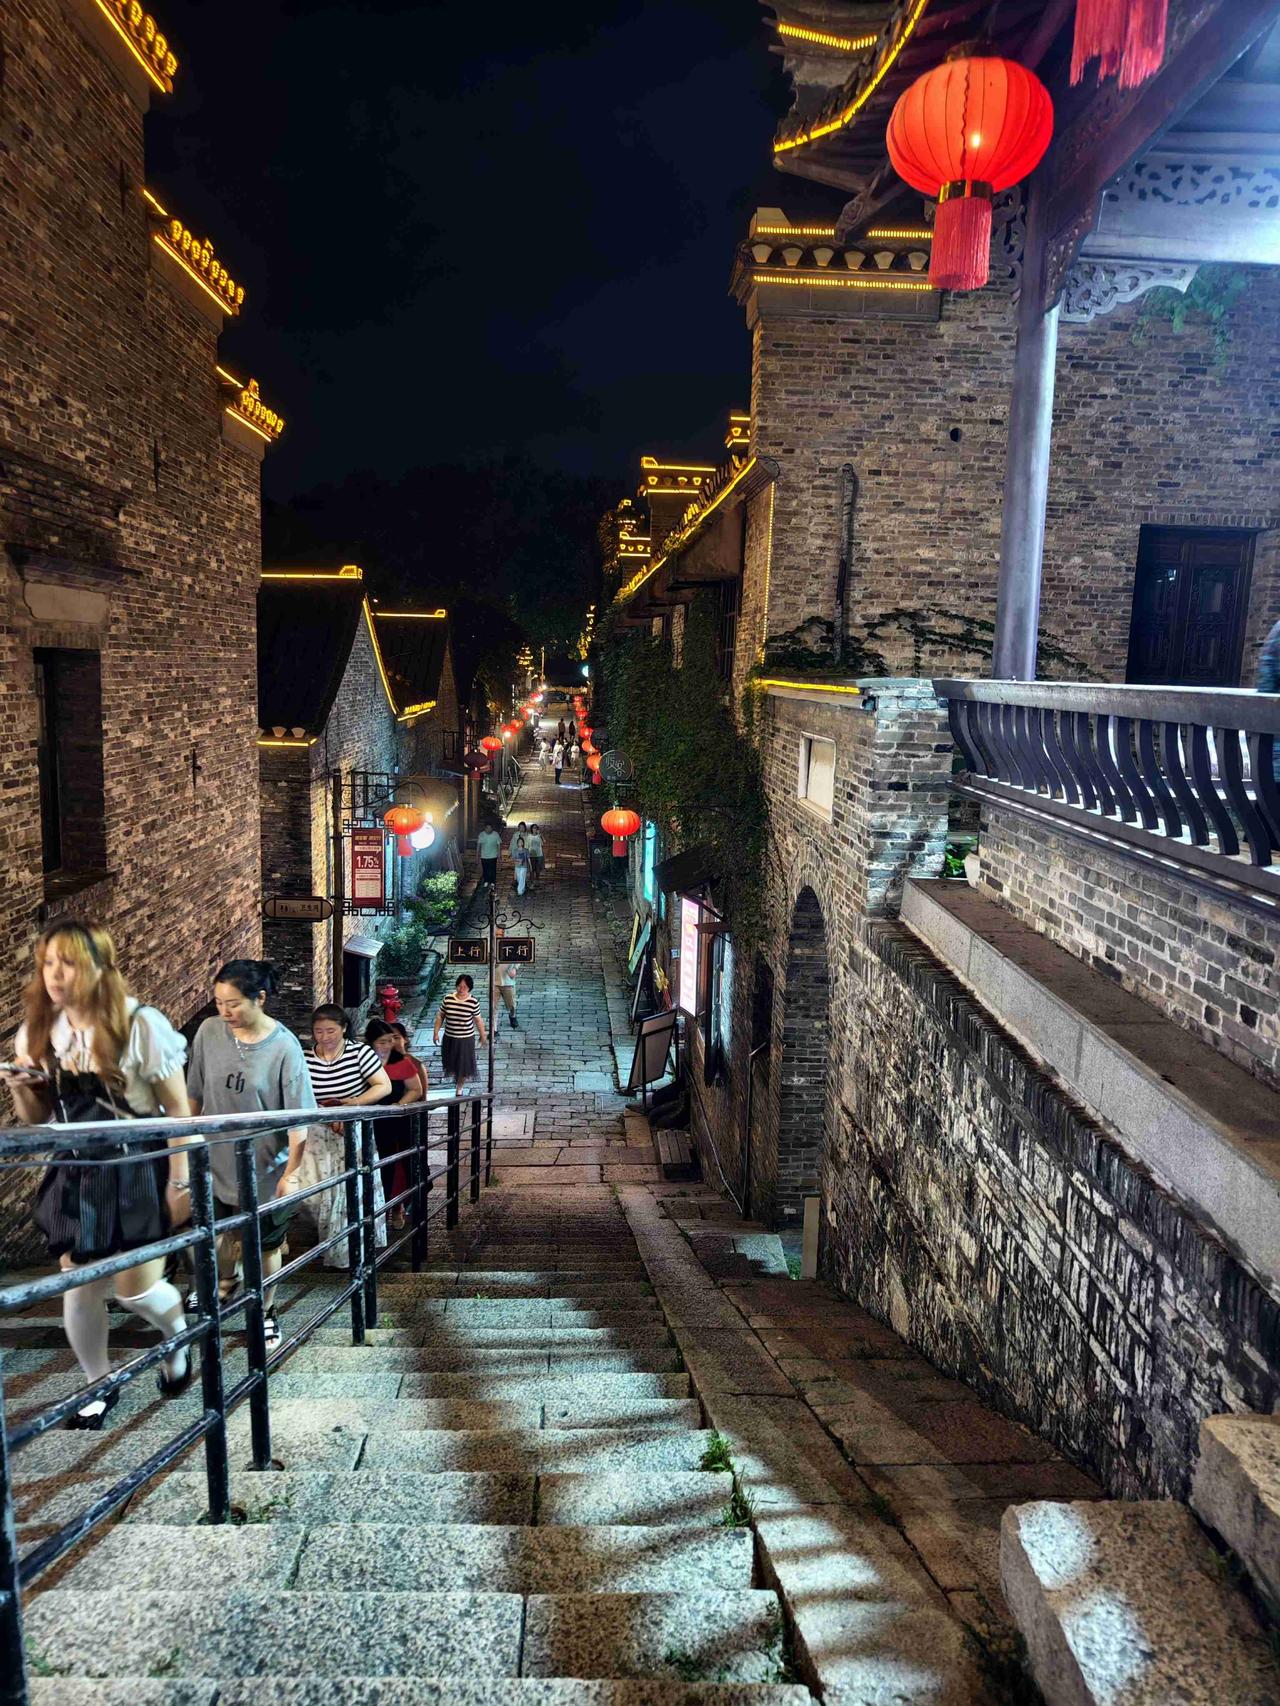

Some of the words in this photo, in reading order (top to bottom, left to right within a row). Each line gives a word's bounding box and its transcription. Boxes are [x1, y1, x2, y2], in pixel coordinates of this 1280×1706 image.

[453, 945, 481, 957] 上行
[502, 945, 529, 957] 下行
[225, 1071, 245, 1094] ch
